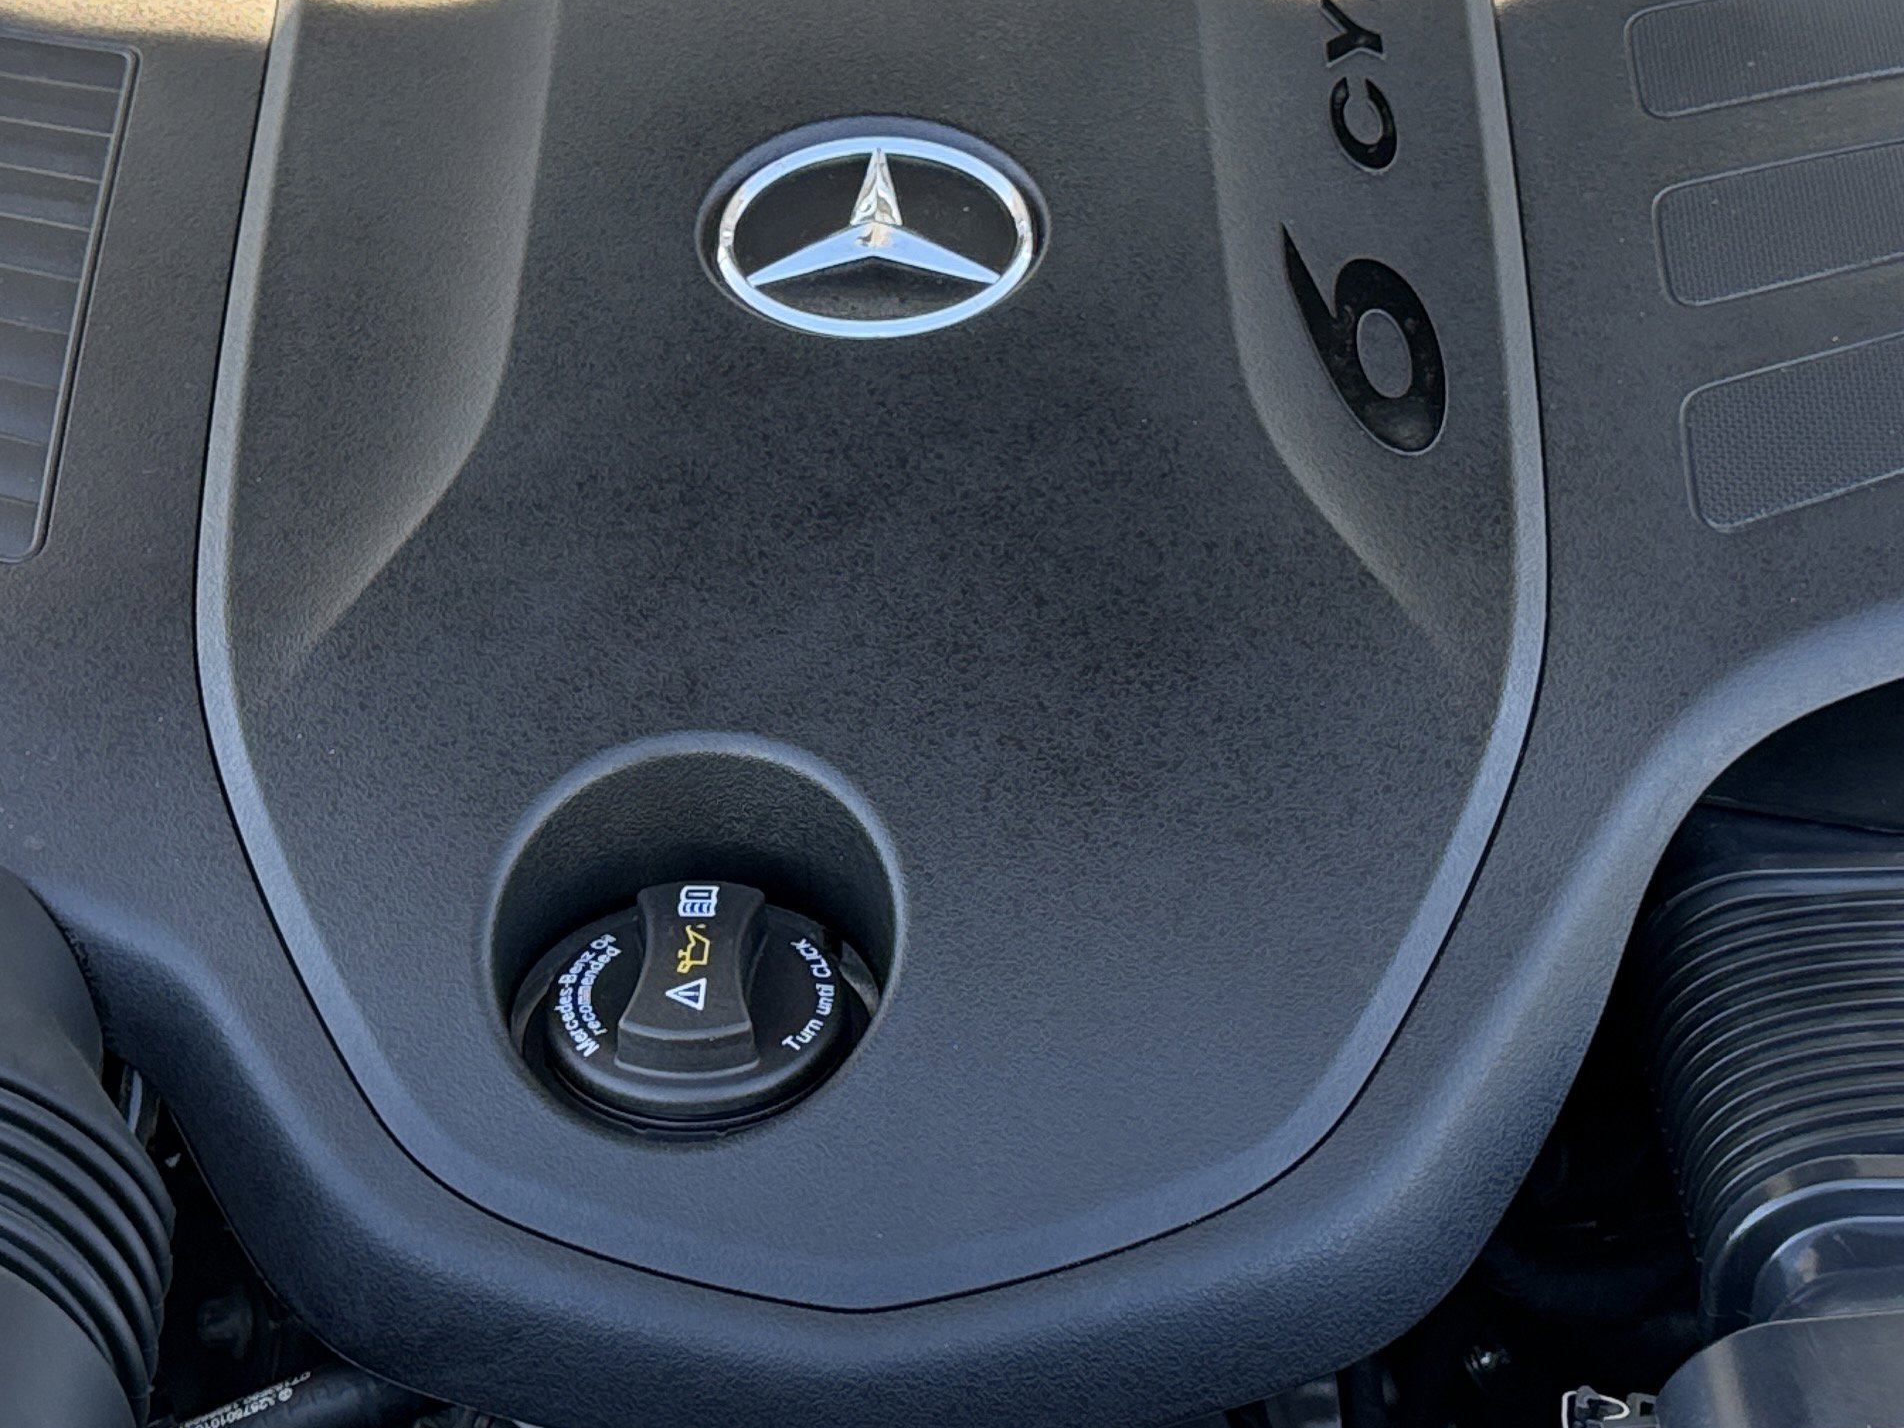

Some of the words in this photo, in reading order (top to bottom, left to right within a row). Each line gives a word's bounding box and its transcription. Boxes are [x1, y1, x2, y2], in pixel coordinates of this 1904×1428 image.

[1280, 222, 1449, 457] 6
[577, 944, 623, 1037] recoended
[789, 938, 833, 979] CLICK
[553, 950, 601, 1058] Mercedes-Benz
[815, 982, 836, 1017] until
[781, 1015, 822, 1053] Turn
